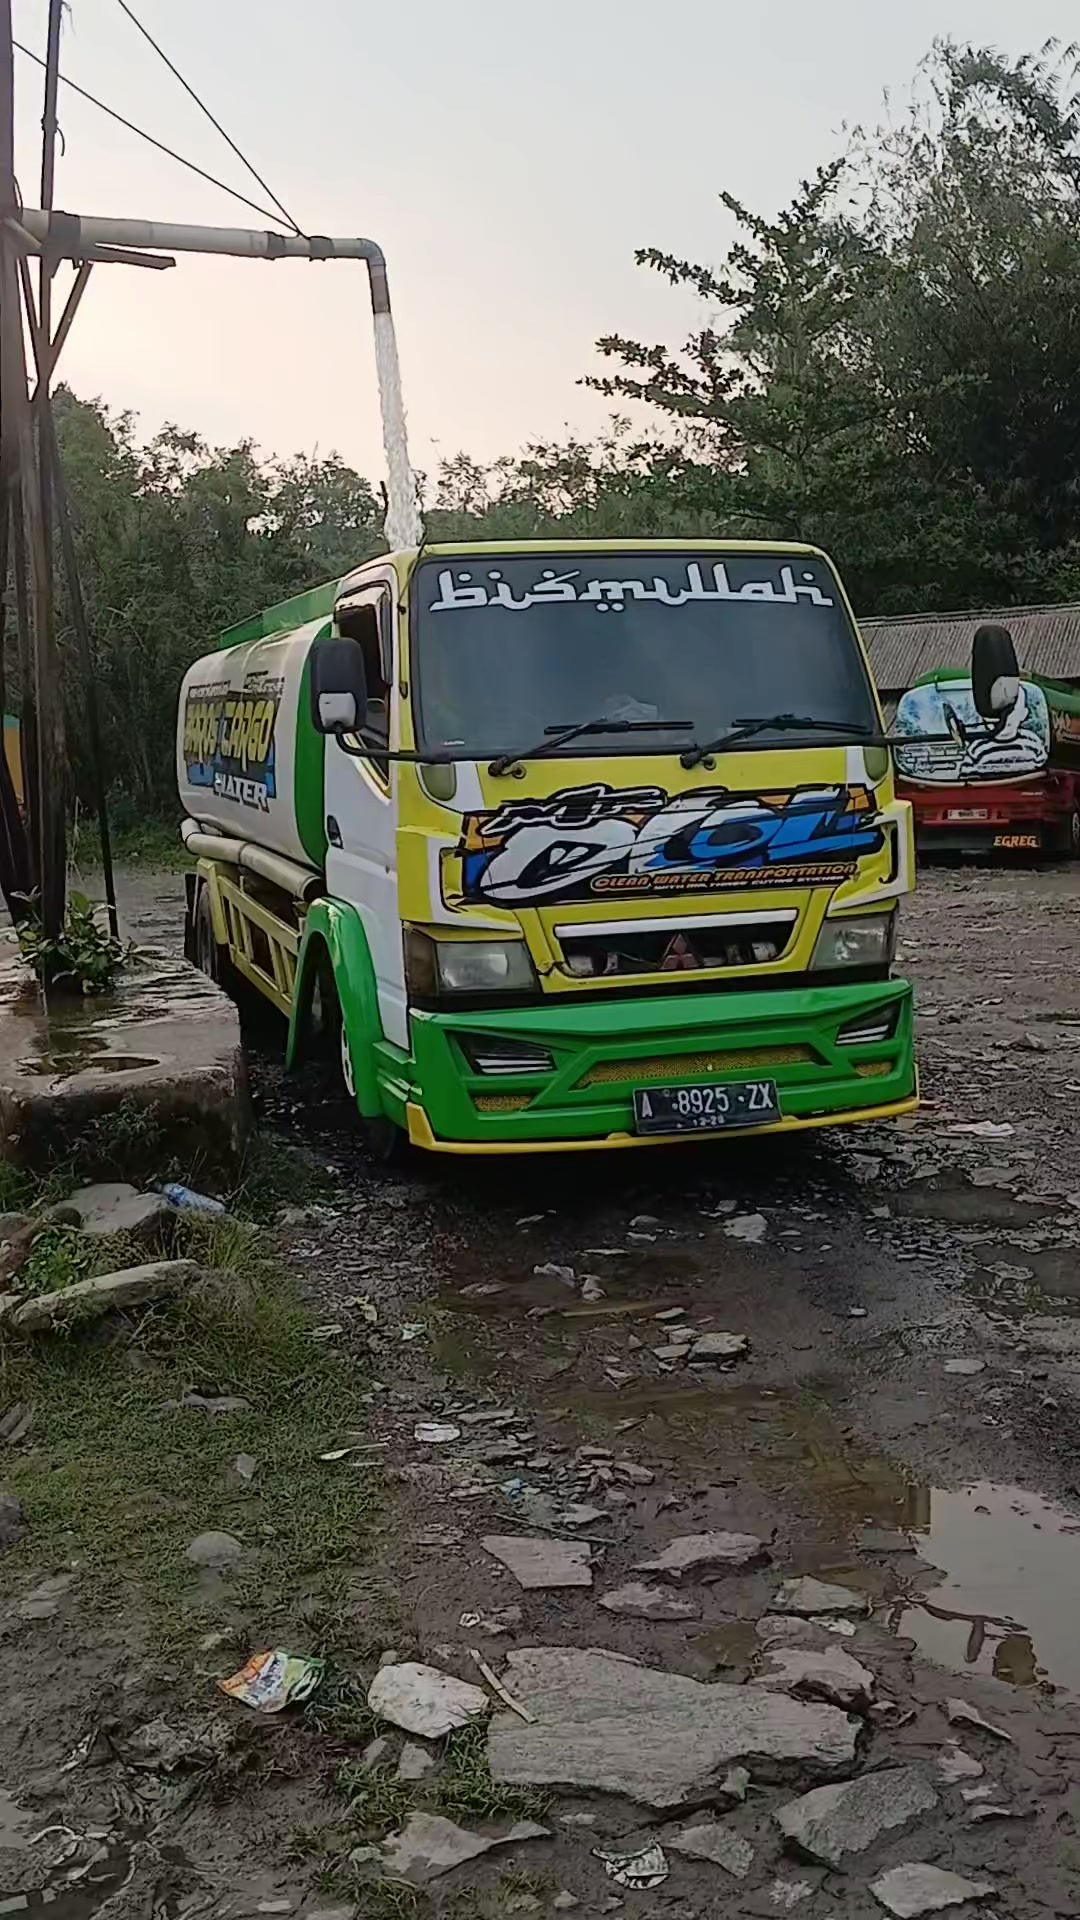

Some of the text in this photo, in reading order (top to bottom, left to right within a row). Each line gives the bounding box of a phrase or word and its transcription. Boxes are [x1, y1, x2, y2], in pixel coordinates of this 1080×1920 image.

[221, 701, 275, 771] CARGO
[595, 876, 650, 888] CLEAN
[653, 873, 712, 885] WATER
[714, 864, 856, 882] TRANSPORTATION
[641, 1083, 774, 1118] A 8925 ZX
